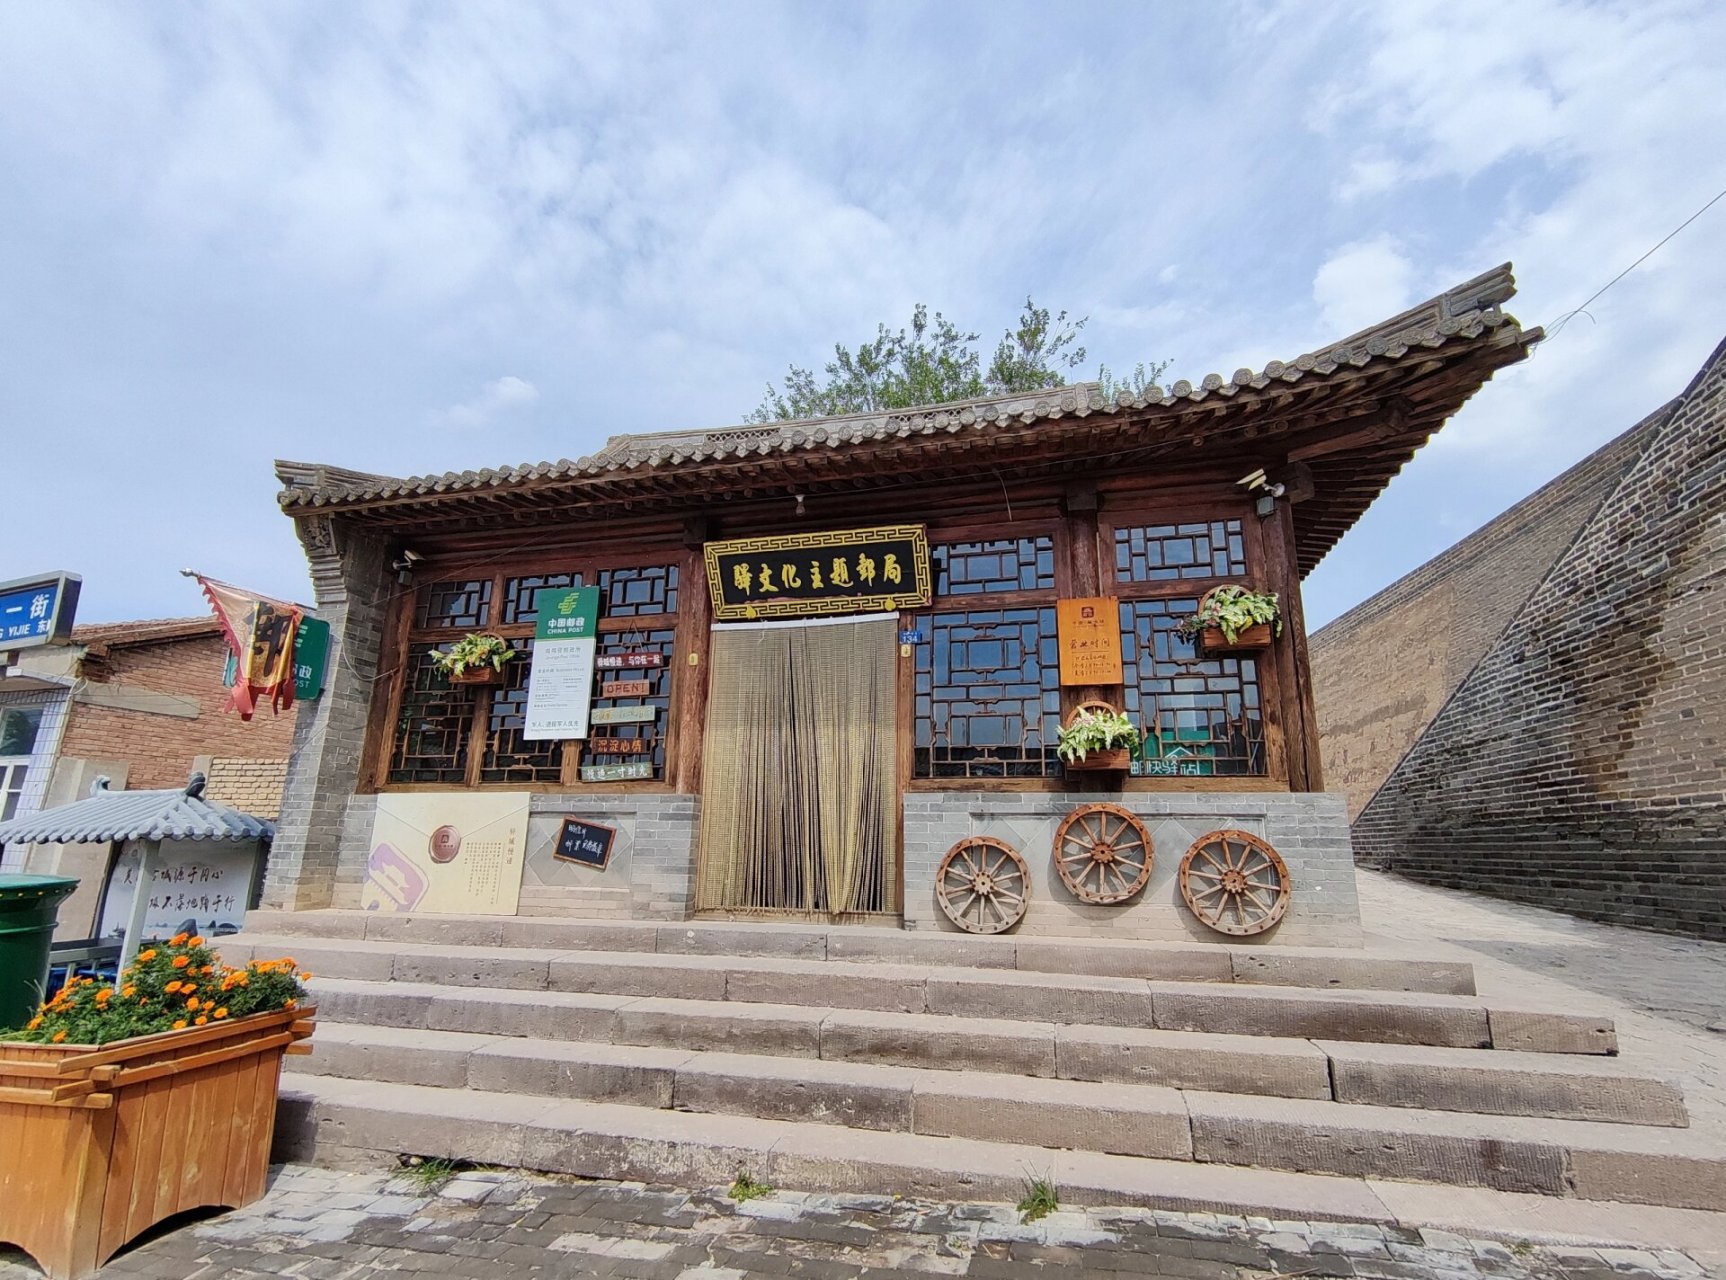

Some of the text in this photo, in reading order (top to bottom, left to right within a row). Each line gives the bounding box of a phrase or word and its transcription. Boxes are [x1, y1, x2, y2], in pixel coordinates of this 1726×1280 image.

[6, 594, 50, 619] 一街
[36, 619, 51, 633] 东
[548, 617, 585, 629] 中国邮政
[8, 623, 31, 637] YIJIE
[606, 683, 645, 693] OPEN!
[598, 740, 642, 753] 沉淀心情
